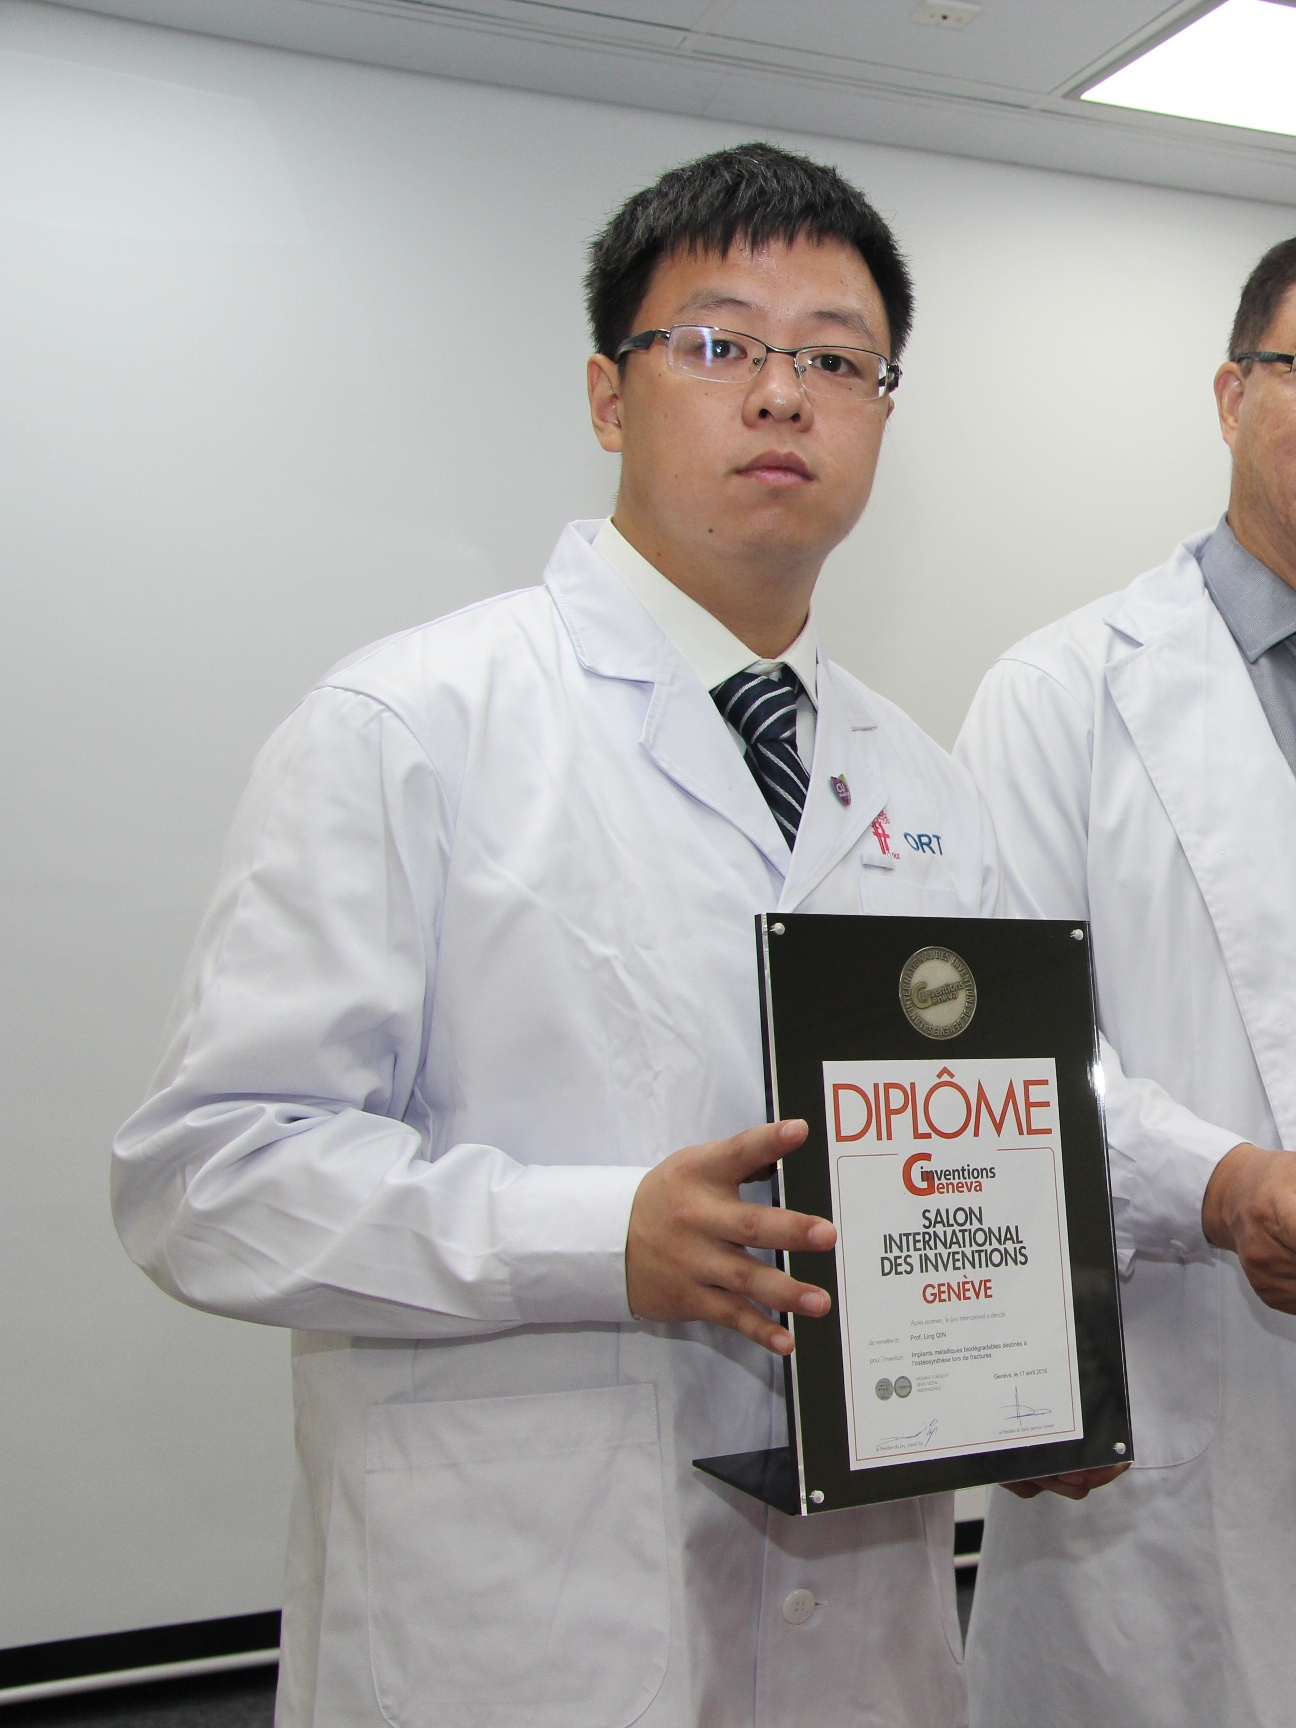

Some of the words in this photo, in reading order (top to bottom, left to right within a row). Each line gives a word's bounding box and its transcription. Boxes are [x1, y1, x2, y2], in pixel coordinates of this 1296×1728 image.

[904, 832, 943, 856] ORT
[832, 1066, 1052, 1142] DIPLÔME
[920, 1164, 996, 1183] inventions
[922, 1206, 983, 1229] SALON
[883, 1225, 1024, 1254] INTERNATIONAL
[880, 1255, 914, 1277] DES
[919, 1246, 1029, 1274] INVENTIONS
[922, 1274, 993, 1304] GENÈVE
[924, 1333, 935, 1341] Ling
[912, 1351, 934, 1359] Implants
[964, 1342, 1002, 1352] biodégradables
[1002, 1341, 1023, 1349] destinés
[962, 1354, 970, 1362] de
[970, 1352, 992, 1360] fractures
